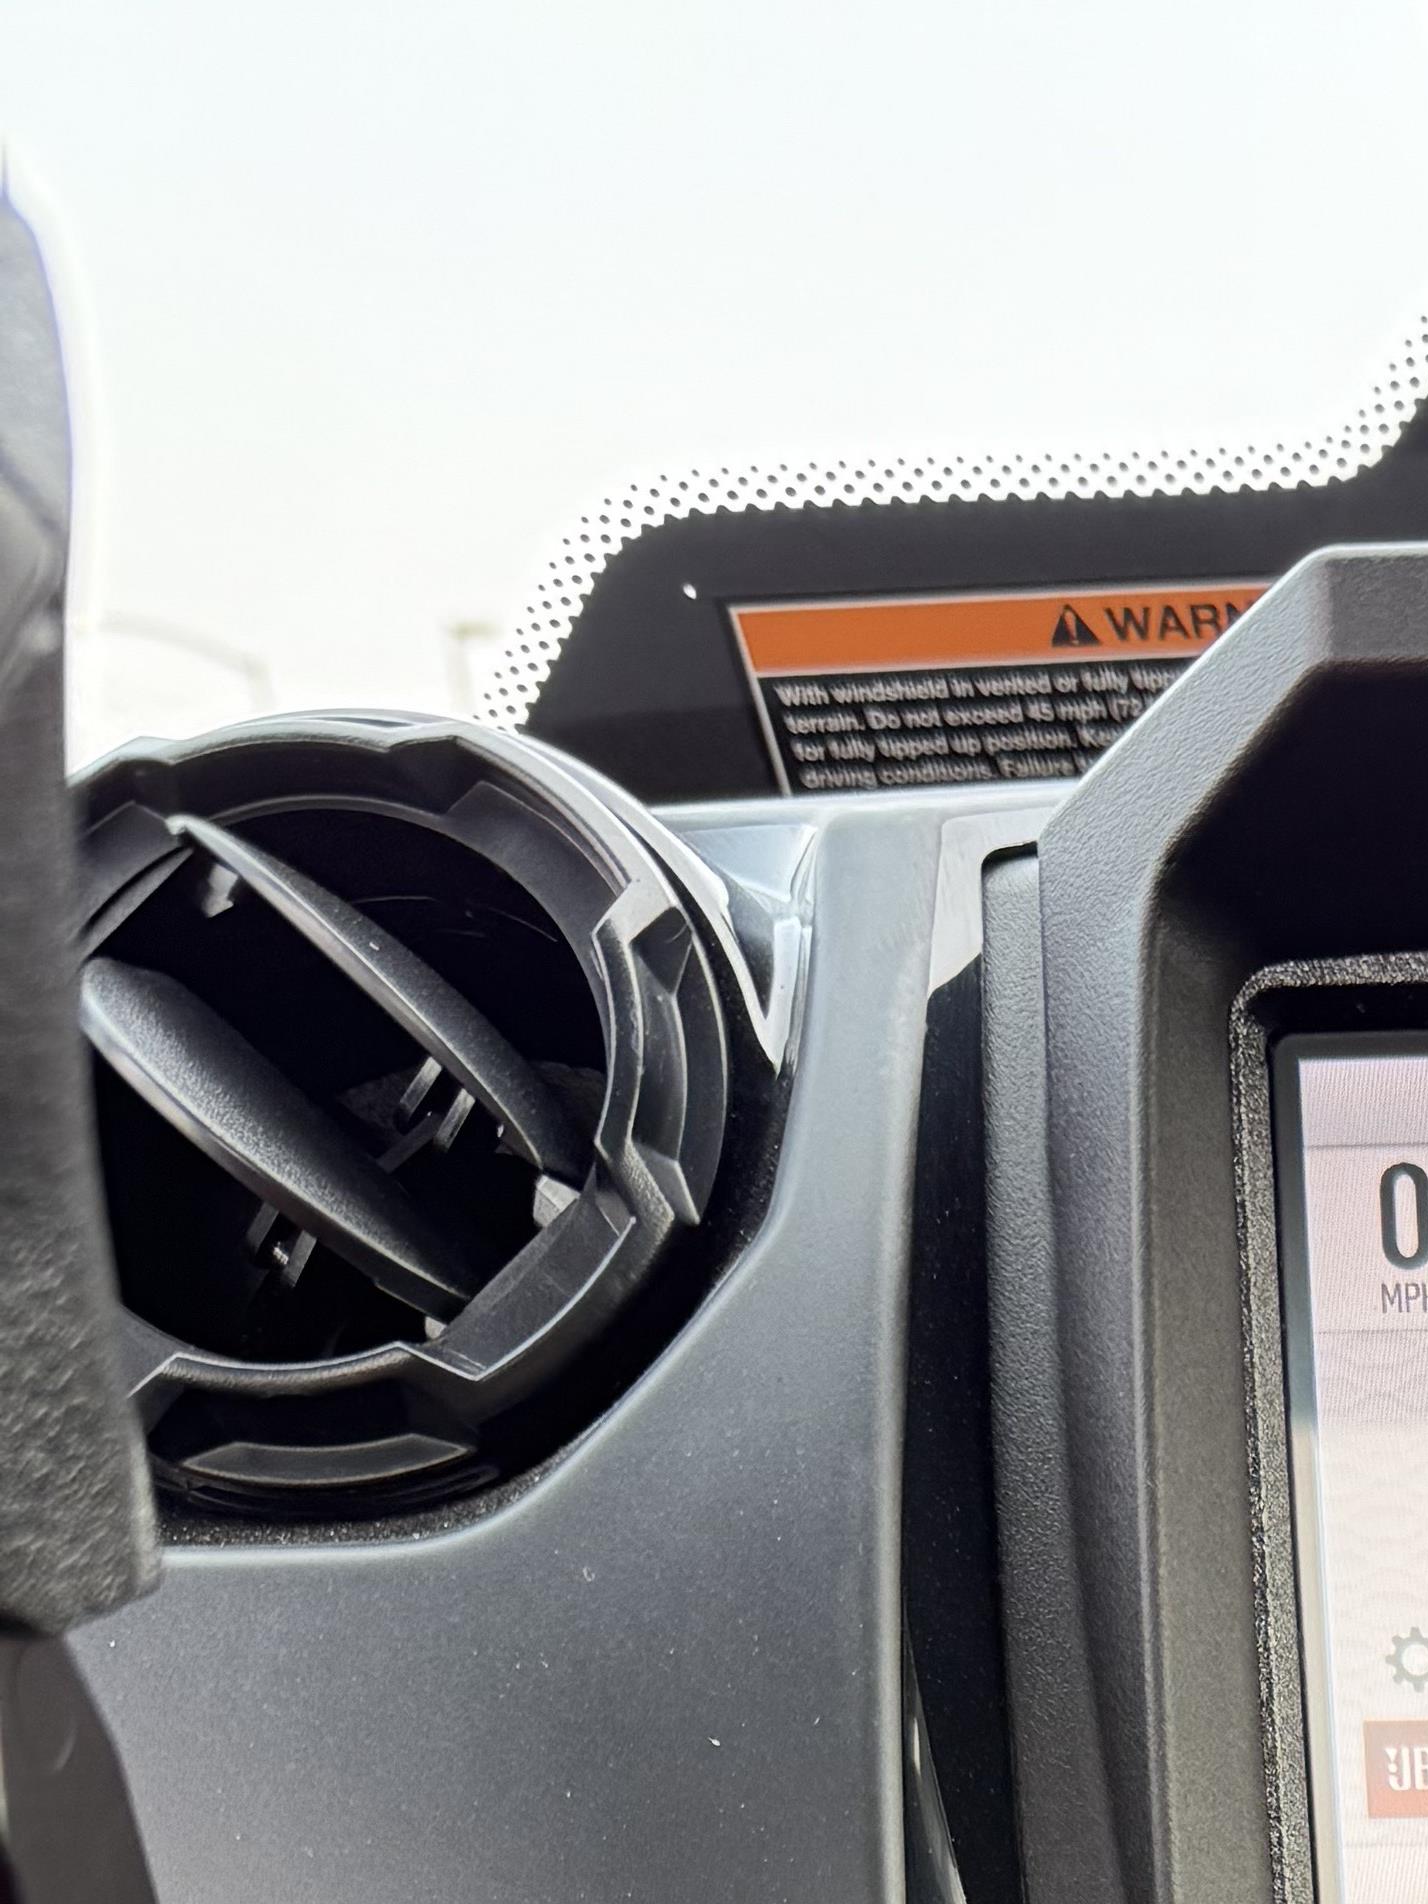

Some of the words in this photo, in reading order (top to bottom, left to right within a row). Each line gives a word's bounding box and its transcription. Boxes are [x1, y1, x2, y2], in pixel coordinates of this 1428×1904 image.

[776, 682, 829, 707] With
[828, 676, 949, 705] windshield
[948, 675, 974, 698] in
[1052, 672, 1079, 694] or
